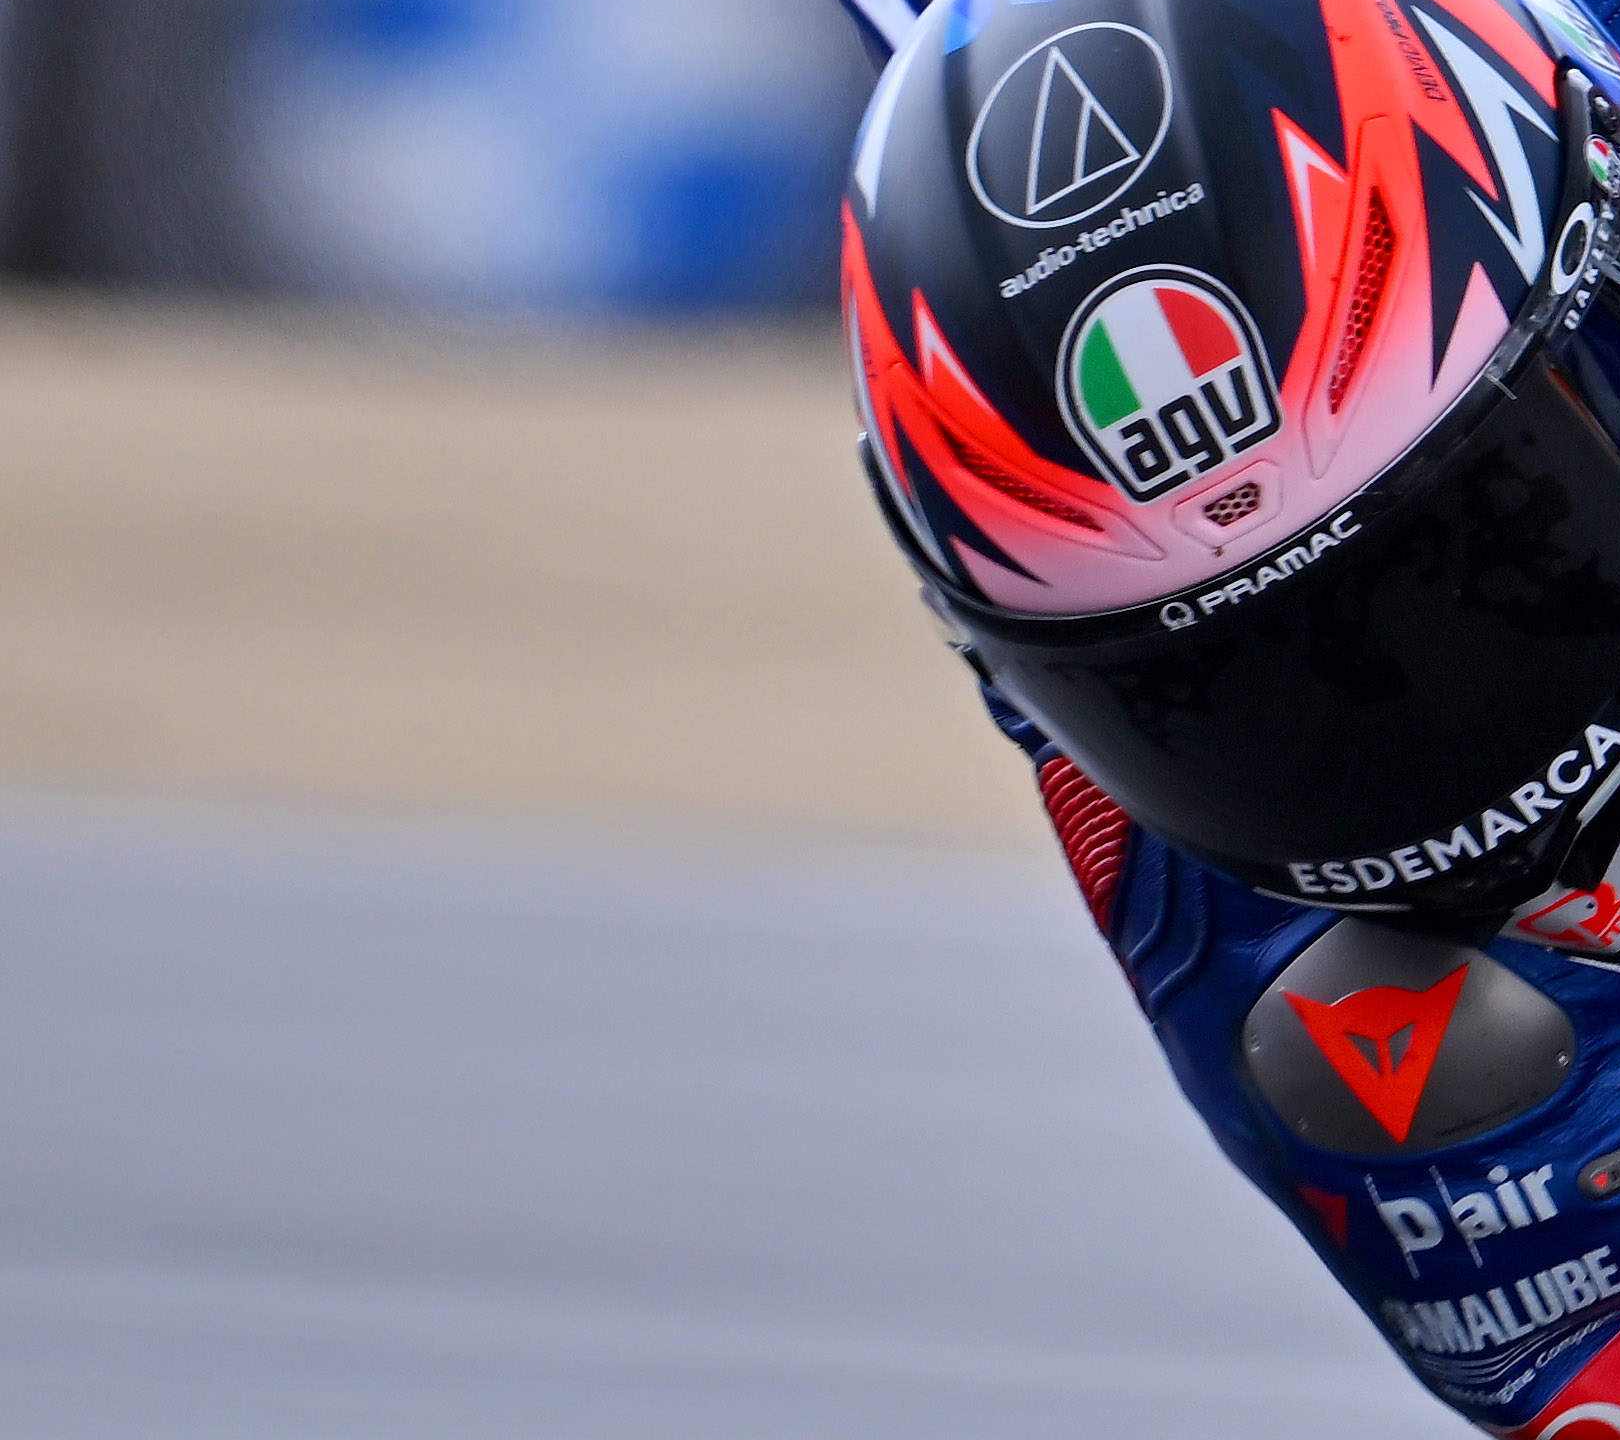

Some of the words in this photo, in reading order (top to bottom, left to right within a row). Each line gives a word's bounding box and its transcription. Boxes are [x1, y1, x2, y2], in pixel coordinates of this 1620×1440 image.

[1000, 184, 1204, 299] audio-technica
[1120, 366, 1258, 484] agv
[1197, 511, 1363, 616] PRAMAC
